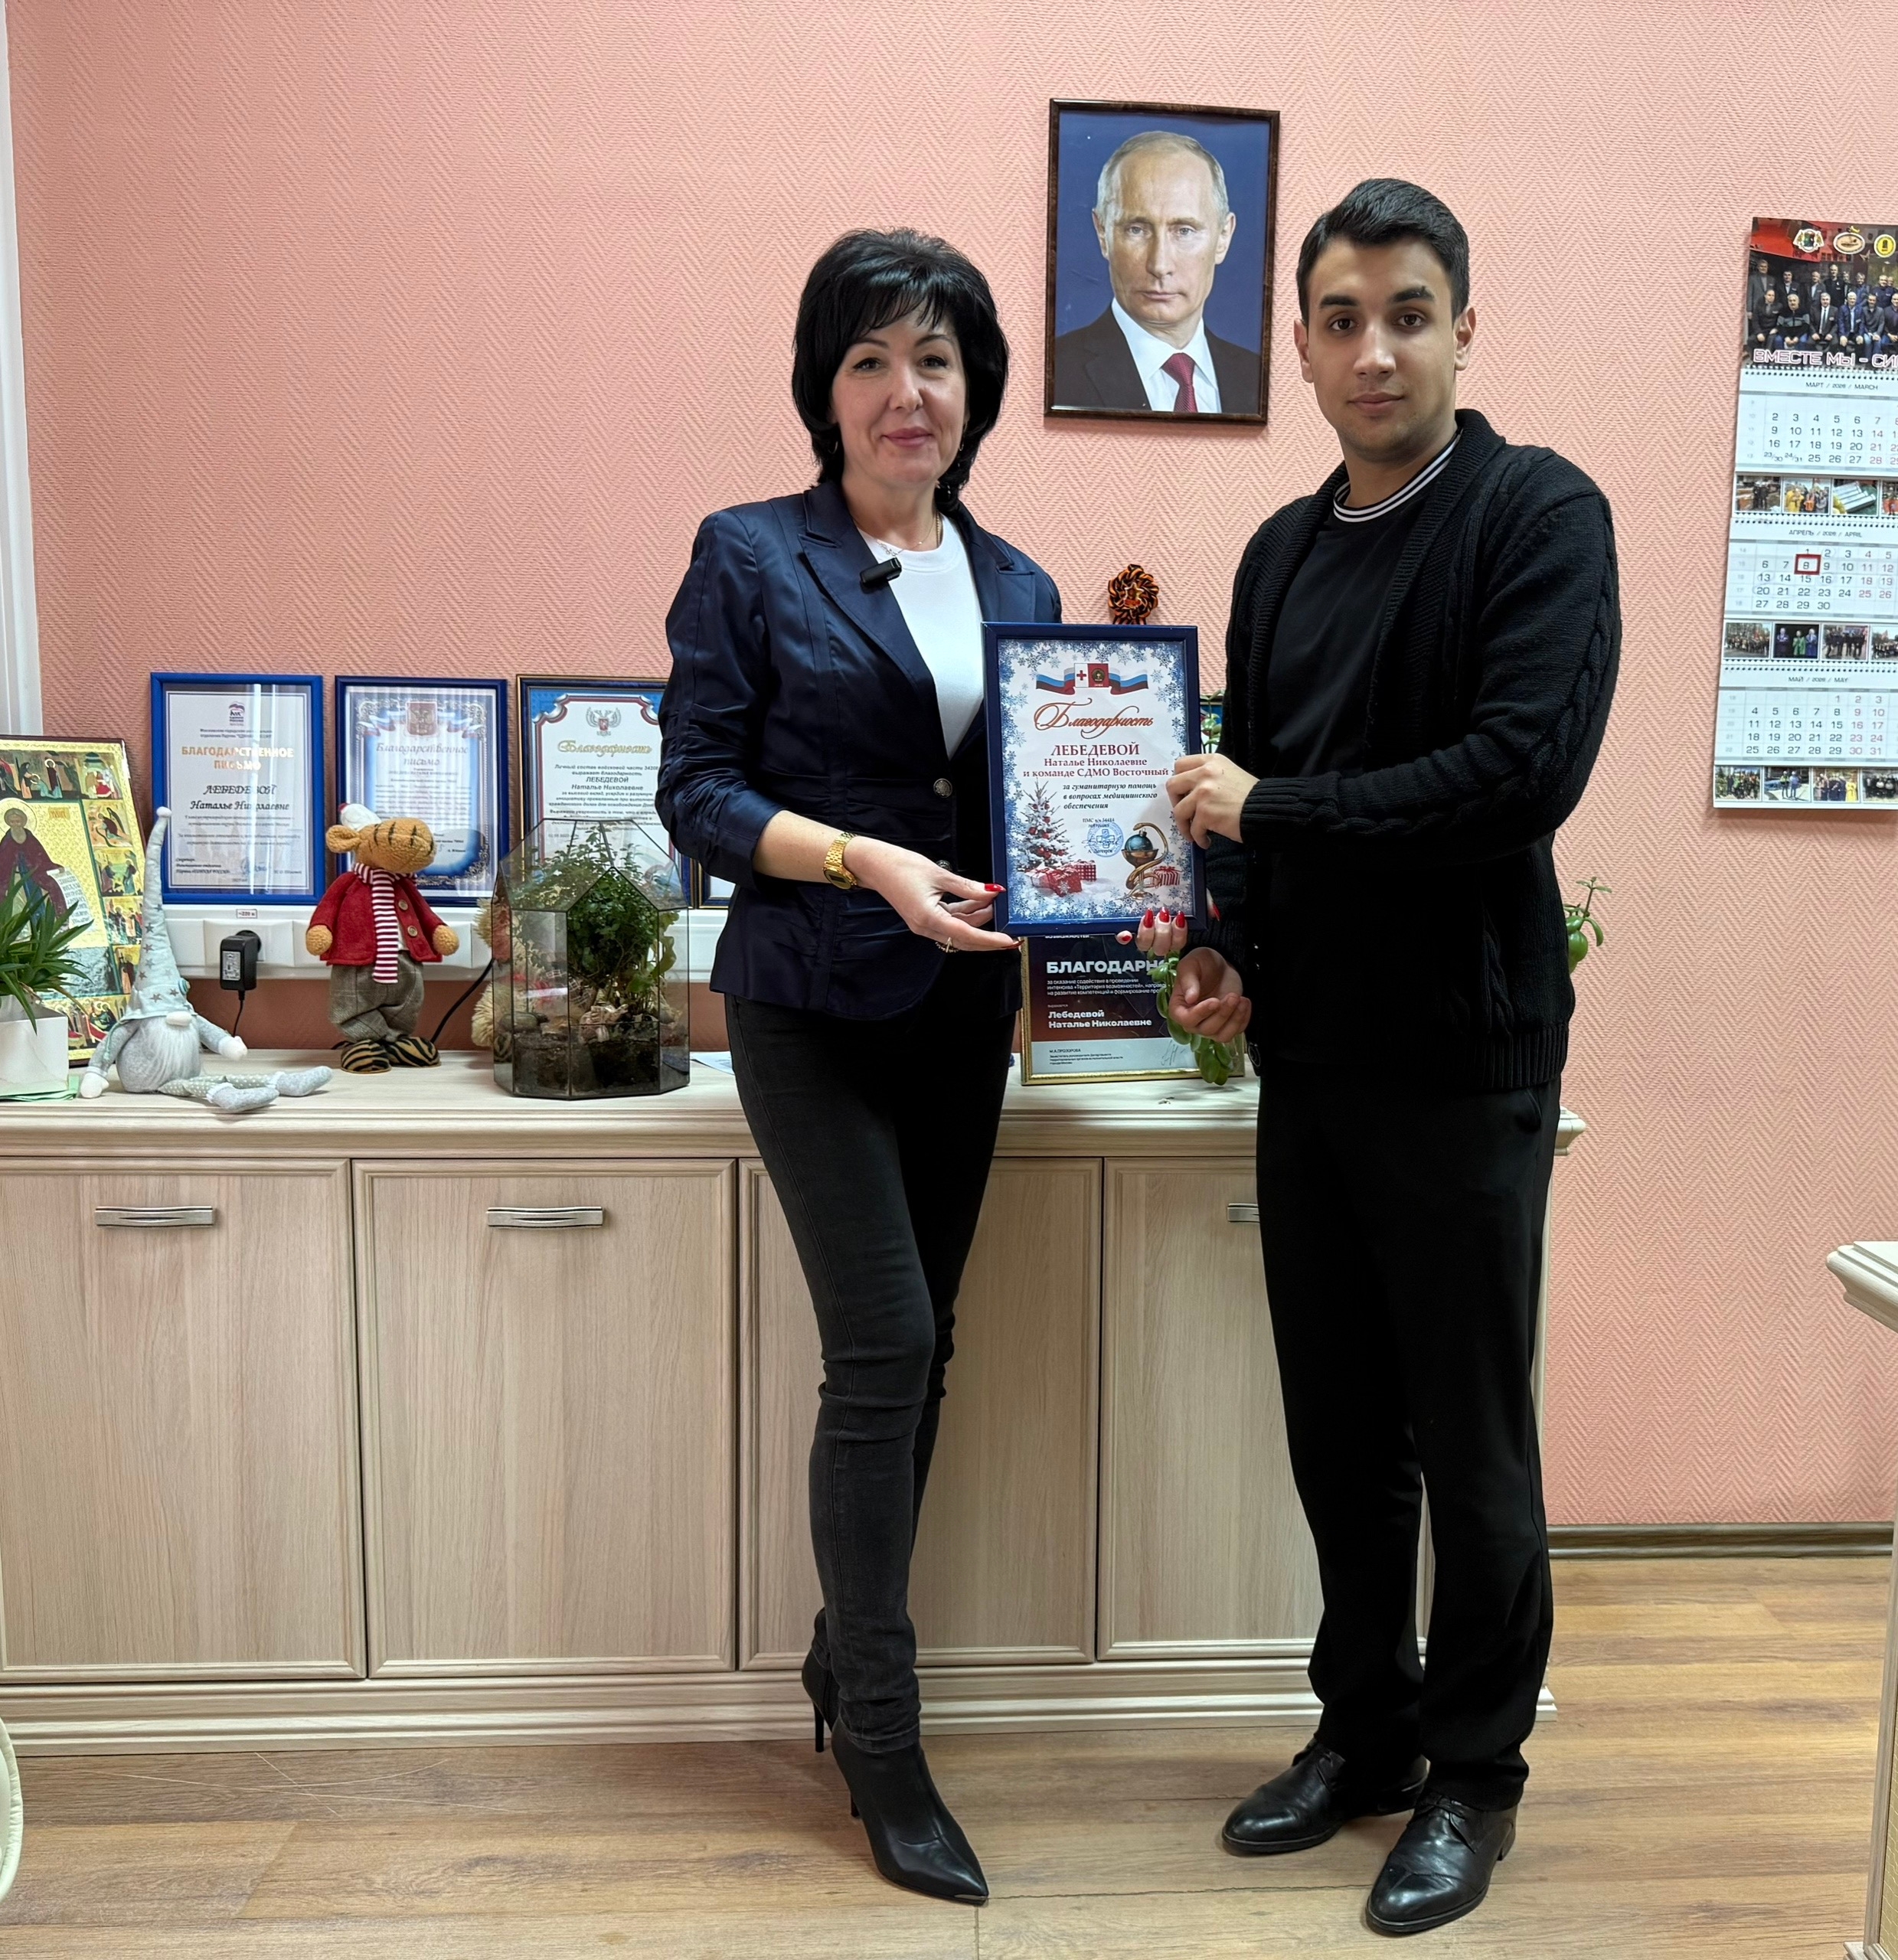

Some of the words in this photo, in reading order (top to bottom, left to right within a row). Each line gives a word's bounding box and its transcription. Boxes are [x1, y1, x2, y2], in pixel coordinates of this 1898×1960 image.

[1753, 348, 1823, 365] ВМЕСТЕ
[1826, 351, 1855, 366] МЫ
[1872, 354, 1898, 368] СИ
[1769, 439, 1780, 448] 16
[1808, 454, 1821, 462] 25
[1829, 455, 1841, 463] 26
[1870, 456, 1882, 465] 28
[1825, 549, 1831, 557] 2
[1845, 550, 1851, 558] 3
[1803, 561, 1809, 570] 8
[1824, 562, 1830, 570] 9
[1842, 563, 1854, 571] 10
[1759, 573, 1770, 582] 13
[1841, 576, 1852, 584] 17
[1861, 577, 1872, 585] 18
[1882, 577, 1893, 586] 19
[1756, 586, 1769, 595] 20
[1777, 587, 1789, 596] 21
[1798, 588, 1810, 596] 22
[1838, 589, 1851, 597] 24
[1859, 590, 1871, 598] 25
[1879, 590, 1891, 599] 26
[1776, 600, 1789, 609] 28
[1797, 601, 1809, 609] 29
[1793, 707, 1798, 716] 6
[1854, 708, 1860, 717] 9
[1034, 697, 1154, 739] Благодарность
[1809, 733, 1821, 742] 21
[1050, 742, 1140, 757] ЛЕБЕДЕВОЙ
[1767, 746, 1779, 754] 26
[1044, 758, 1084, 766] Наталье
[1087, 758, 1147, 766] Николаевне
[1076, 768, 1110, 777] СДМО
[1113, 768, 1168, 776] Восточный
[190, 801, 232, 810] Наталье
[234, 801, 289, 812] Ниолаевне
[1048, 1010, 1104, 1019] Лебедевой
[1092, 1019, 1152, 1027] Николаевне
